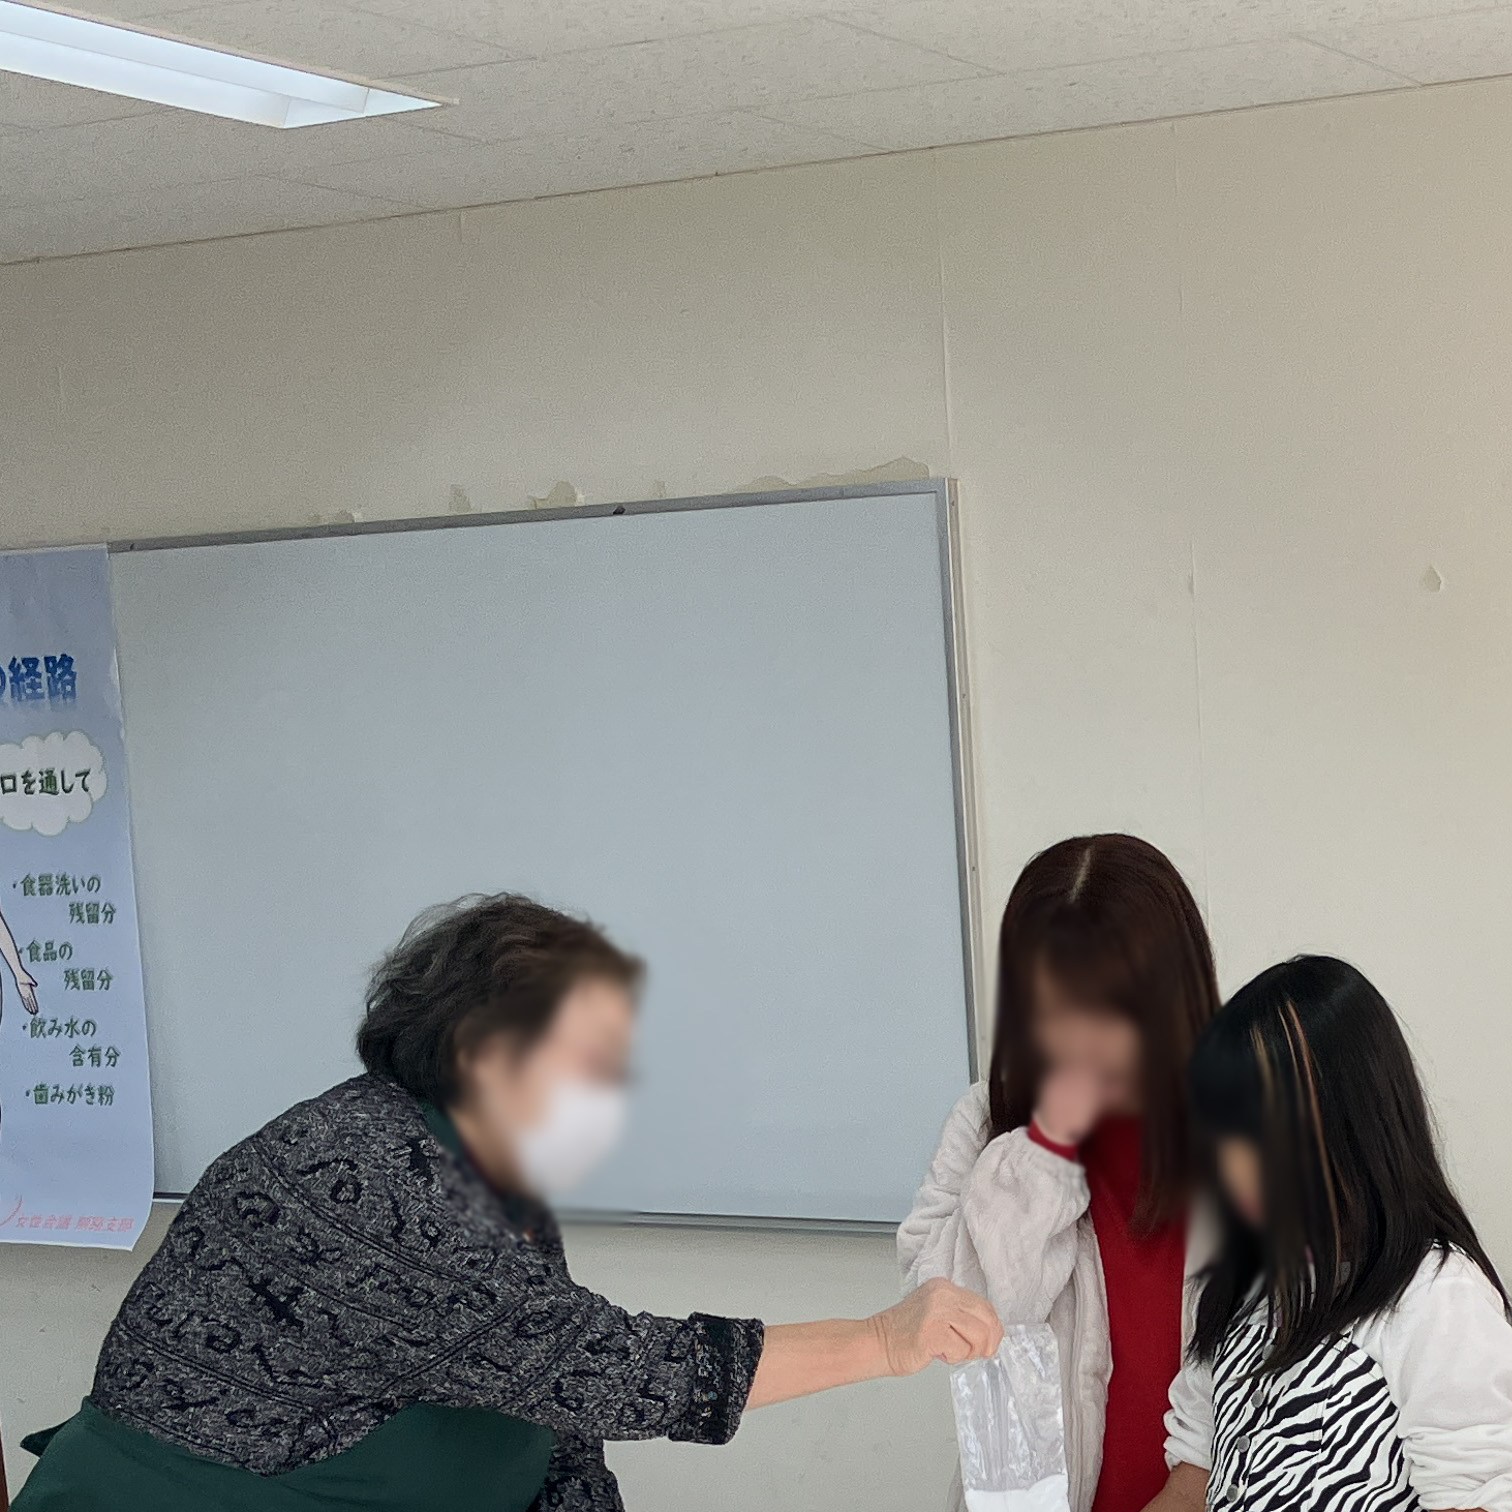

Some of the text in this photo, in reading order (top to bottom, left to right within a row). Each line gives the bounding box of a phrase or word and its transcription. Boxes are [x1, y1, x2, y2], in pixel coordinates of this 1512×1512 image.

[0, 653, 77, 701] 経路
[68, 901, 116, 924] 残留分
[63, 968, 113, 991] 残留分
[69, 1044, 121, 1067] 含有分
